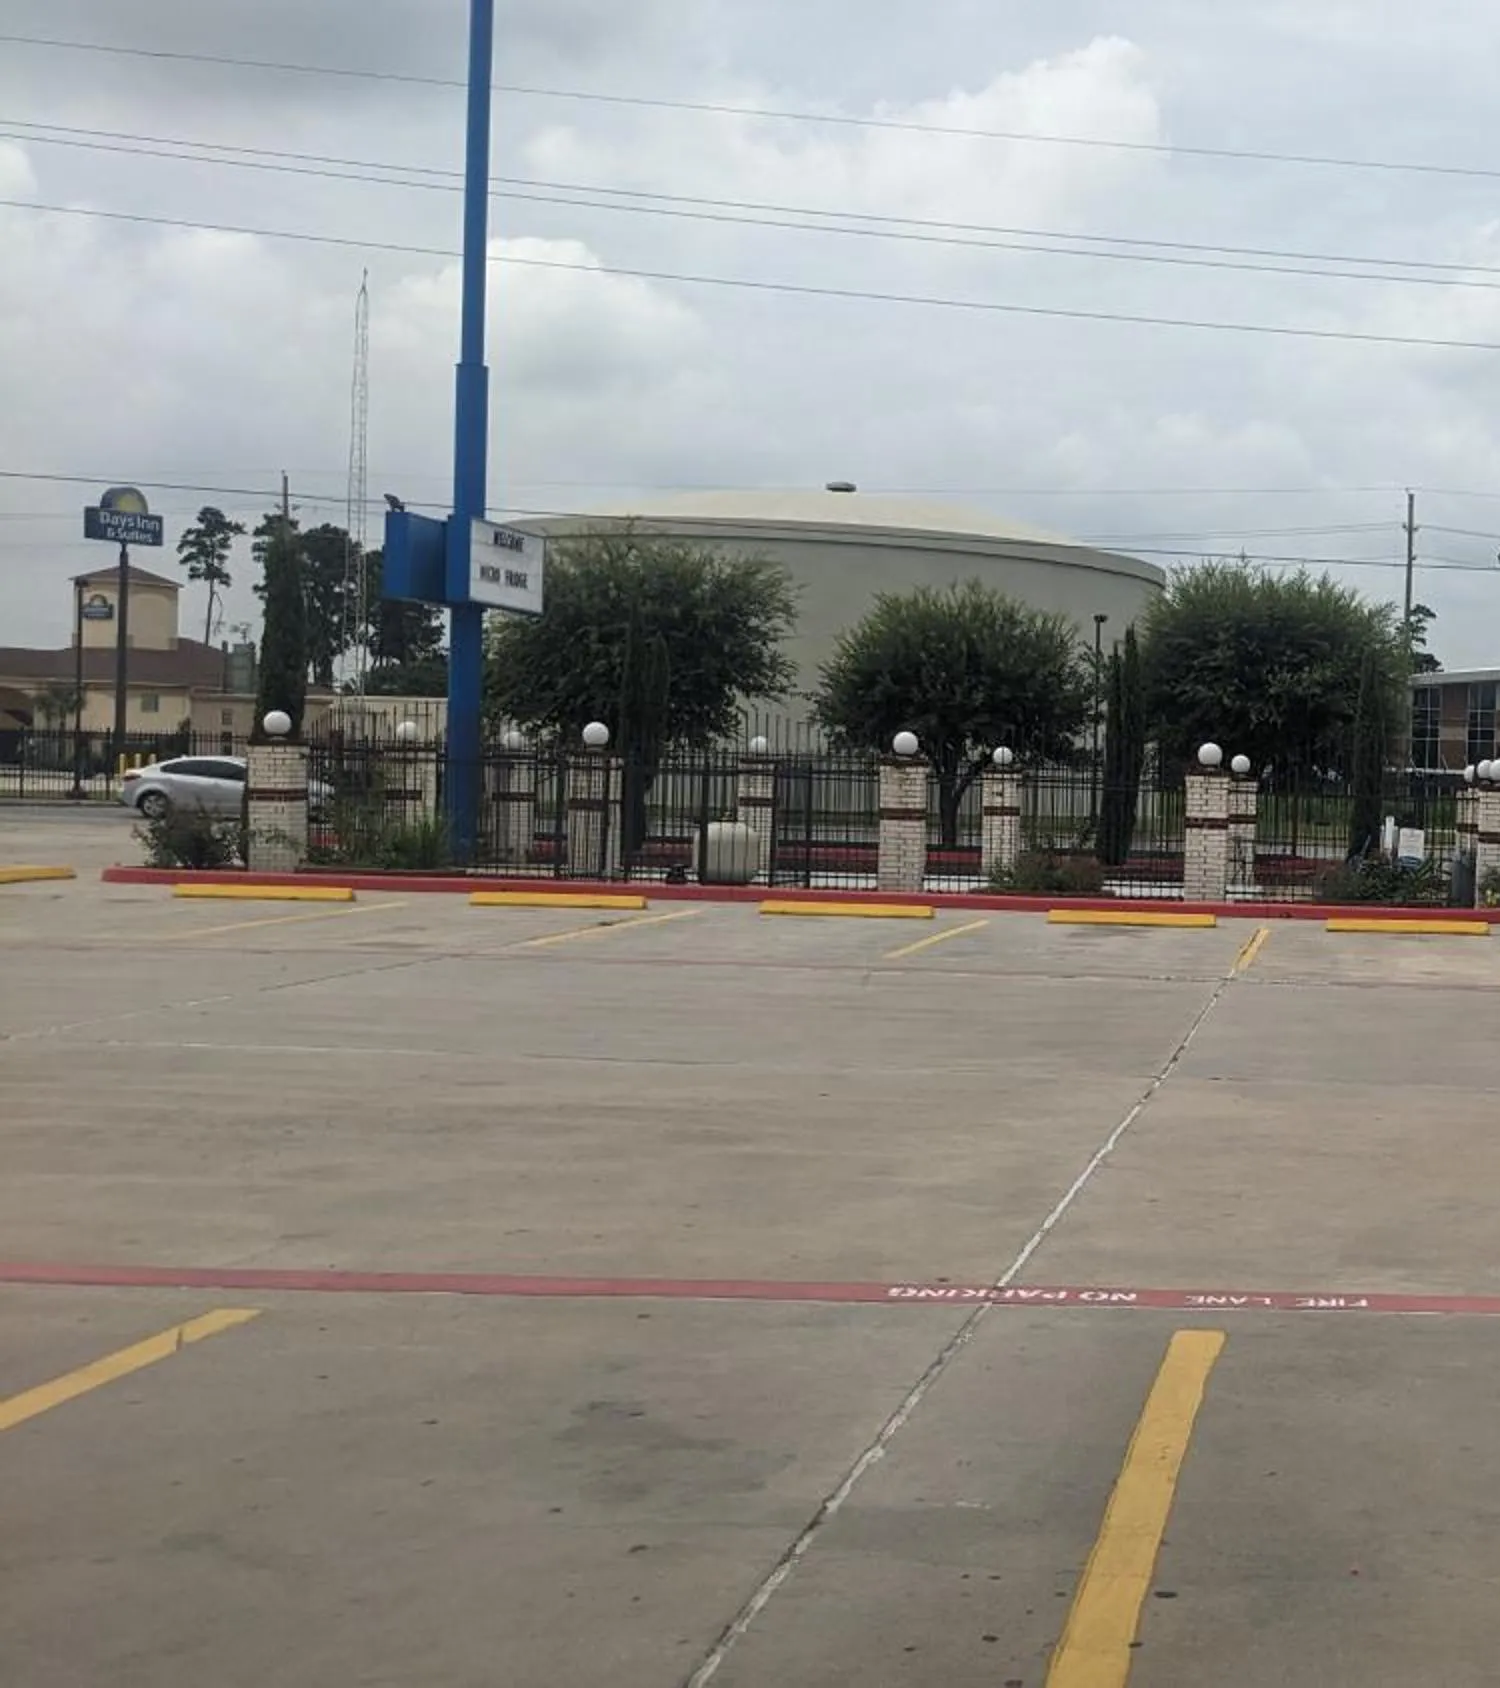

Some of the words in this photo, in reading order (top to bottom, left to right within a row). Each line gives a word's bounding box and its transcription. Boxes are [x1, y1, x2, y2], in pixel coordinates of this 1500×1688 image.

[100, 511, 134, 527] Days
[137, 514, 160, 531] Inn
[116, 529, 153, 542] Suites
[493, 530, 525, 552] WELCOME
[887, 1286, 1068, 1300] PARKING
[1078, 1290, 1138, 1301] NO
[1184, 1295, 1271, 1305] LANE
[1296, 1297, 1368, 1307] FIRE
